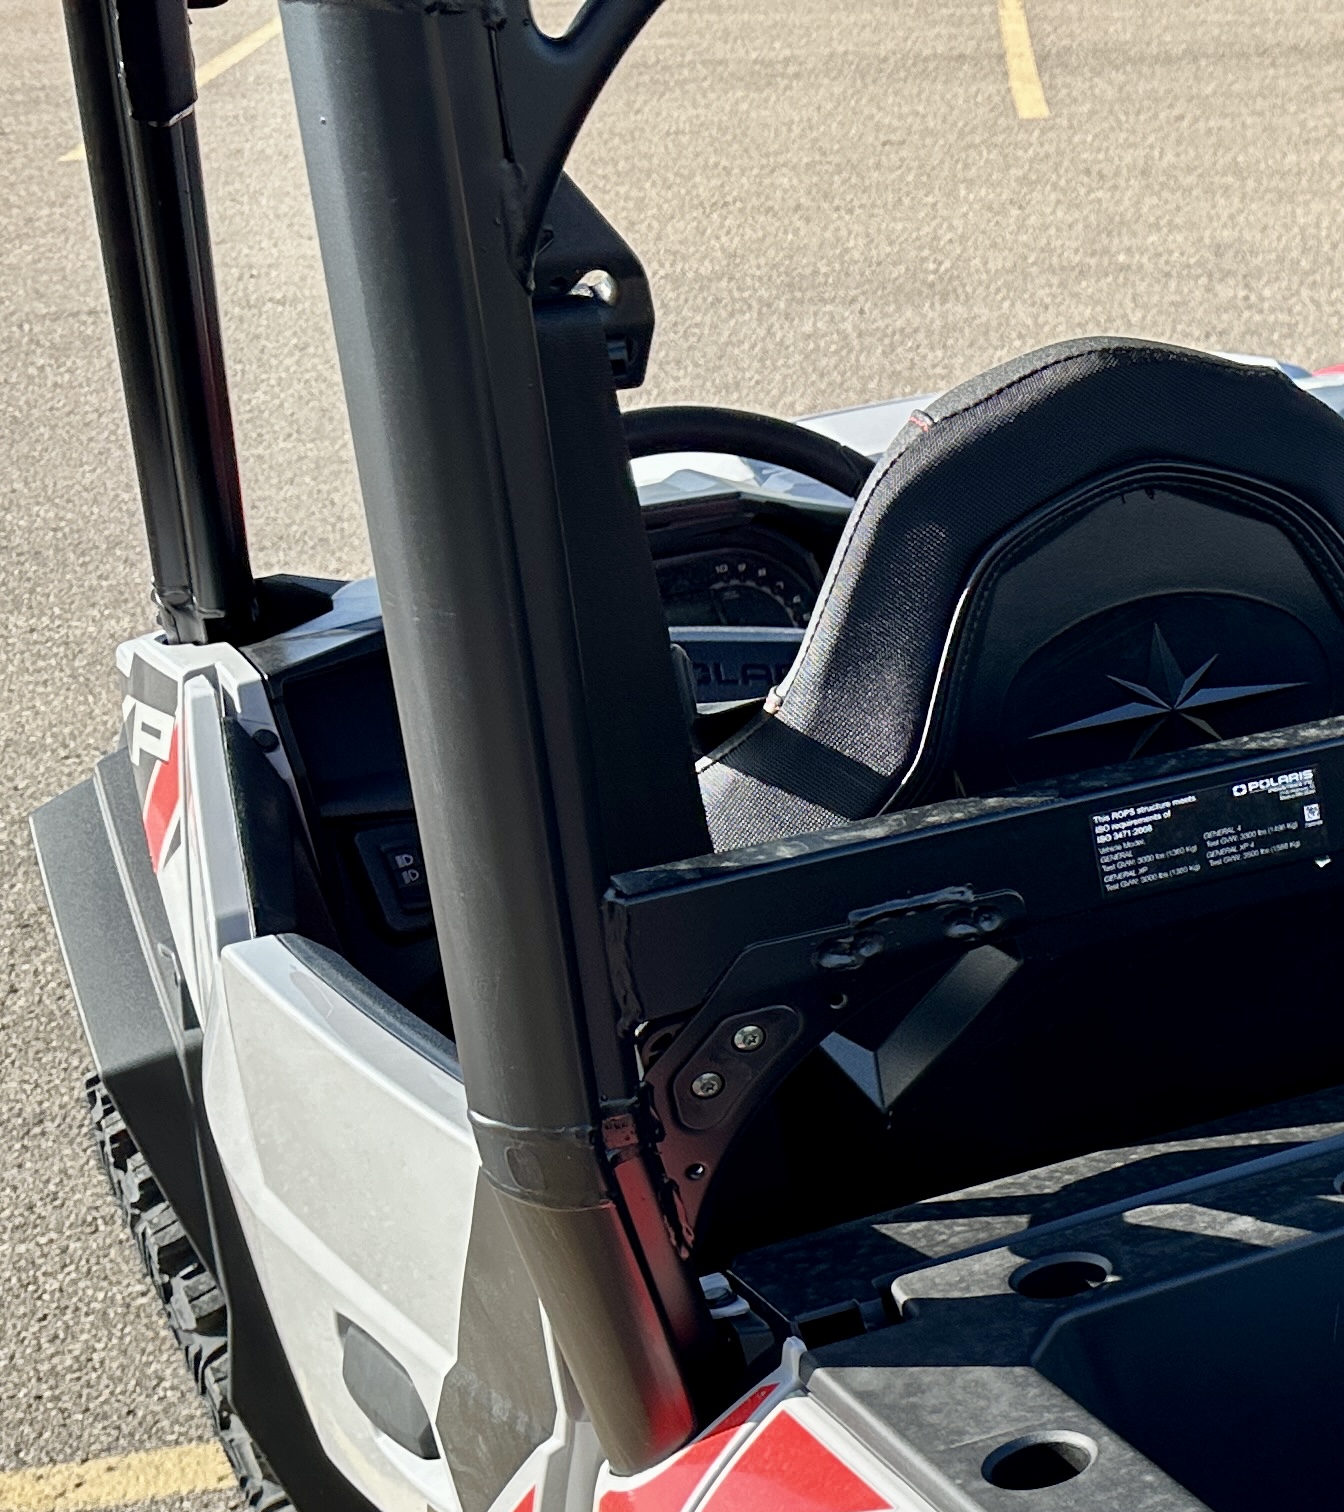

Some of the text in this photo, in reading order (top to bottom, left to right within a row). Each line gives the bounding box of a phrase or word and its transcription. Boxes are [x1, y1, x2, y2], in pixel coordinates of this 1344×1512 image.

[1248, 770, 1313, 792] POLARIS
[1093, 796, 1196, 823] This ROPS structure meets
[1095, 810, 1171, 834] ISO requirements of
[1097, 834, 1112, 843] ISO
[1203, 827, 1235, 839] GENERAL
[1100, 851, 1132, 863] GENERAL
[1206, 846, 1237, 858] GENERAL
[1104, 870, 1136, 882] GENERAL
